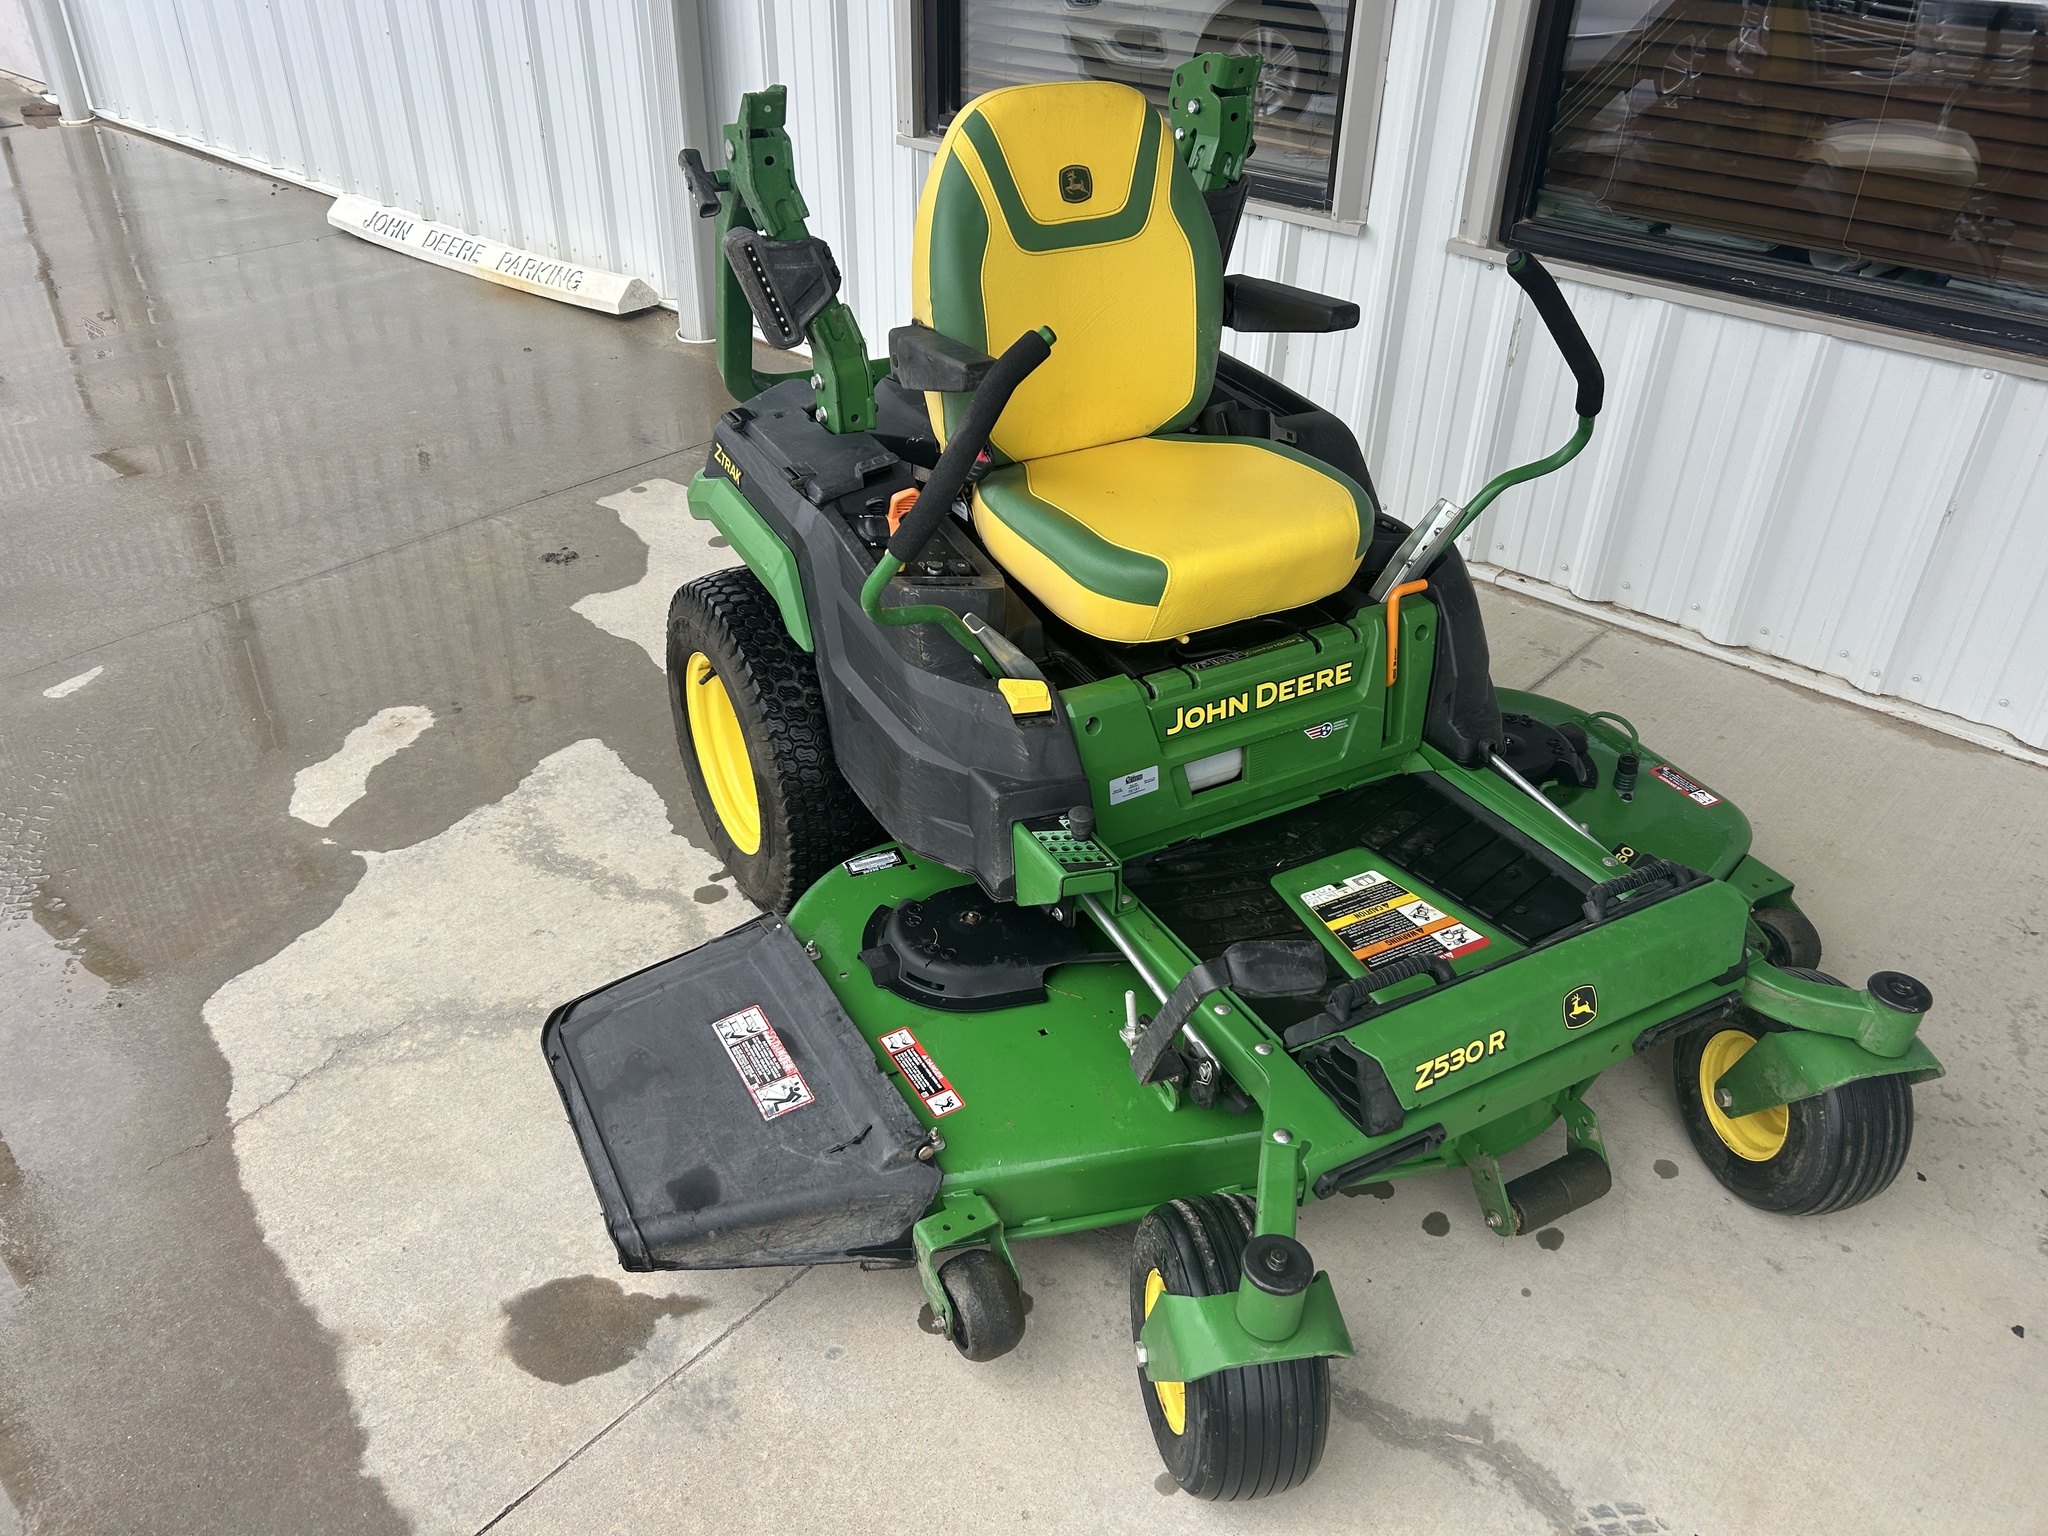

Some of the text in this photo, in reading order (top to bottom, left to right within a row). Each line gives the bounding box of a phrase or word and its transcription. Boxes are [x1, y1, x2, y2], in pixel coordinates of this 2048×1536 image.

[363, 210, 584, 292] JOHN DEERE PARKING
[714, 442, 742, 486] ZTRAK
[1165, 692, 1250, 737] JOHN
[1255, 661, 1354, 711] DEERE
[1615, 845, 1635, 863] 60
[1353, 905, 1385, 920] CAUTION
[1384, 928, 1419, 946] WARNING
[926, 1058, 945, 1081] DANGER
[1414, 1028, 1507, 1092] Z530 R
